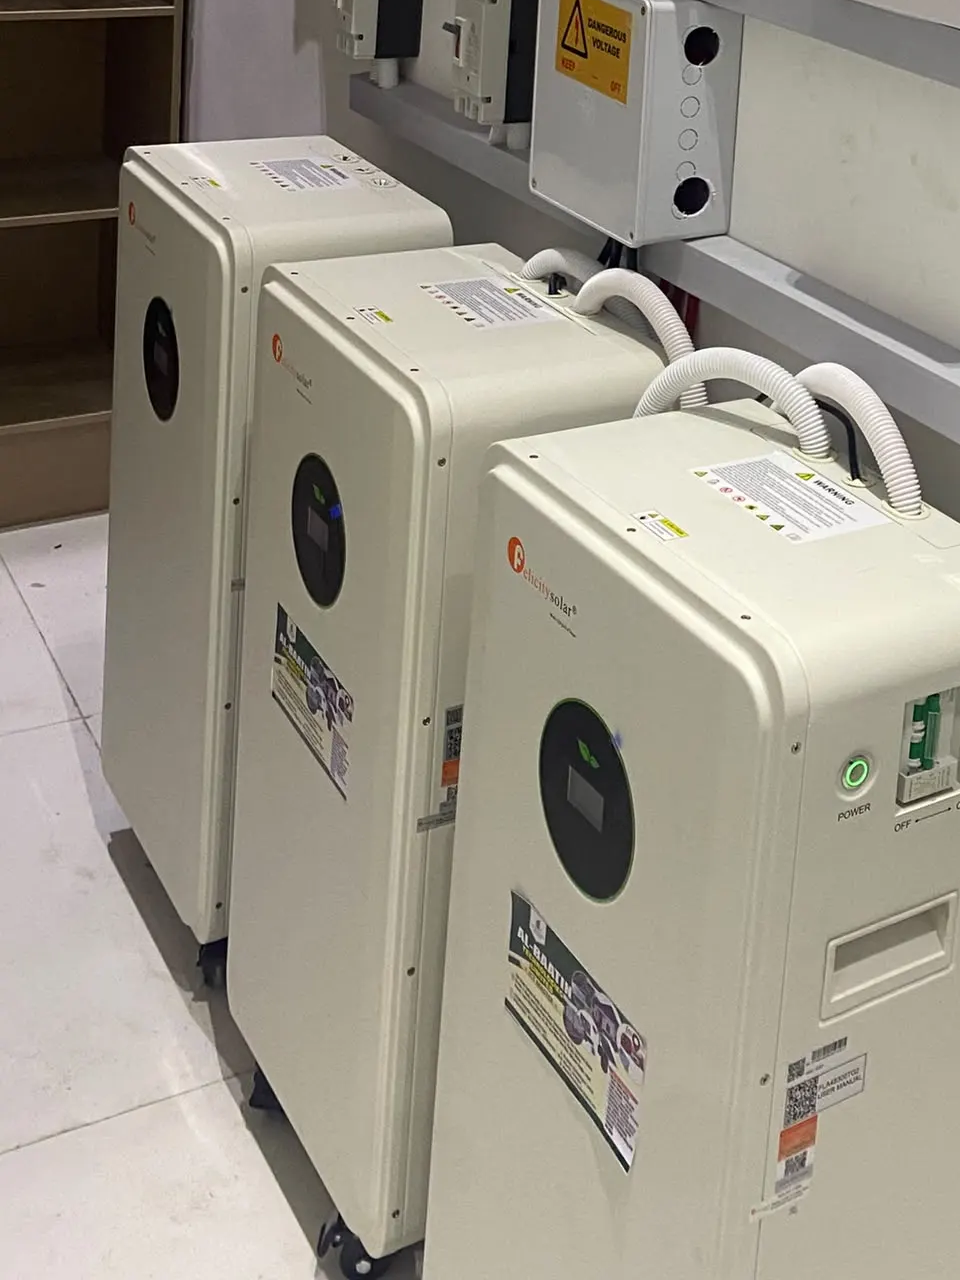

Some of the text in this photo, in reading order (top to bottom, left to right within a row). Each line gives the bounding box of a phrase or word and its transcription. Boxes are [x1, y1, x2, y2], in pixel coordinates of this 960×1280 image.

[587, 17, 627, 44] DANGEROUS
[592, 36, 620, 59] VOLTAGE
[814, 479, 855, 506] WARNING
[837, 803, 912, 833] POWER OFF
[517, 926, 572, 999] AL-BAATIN
